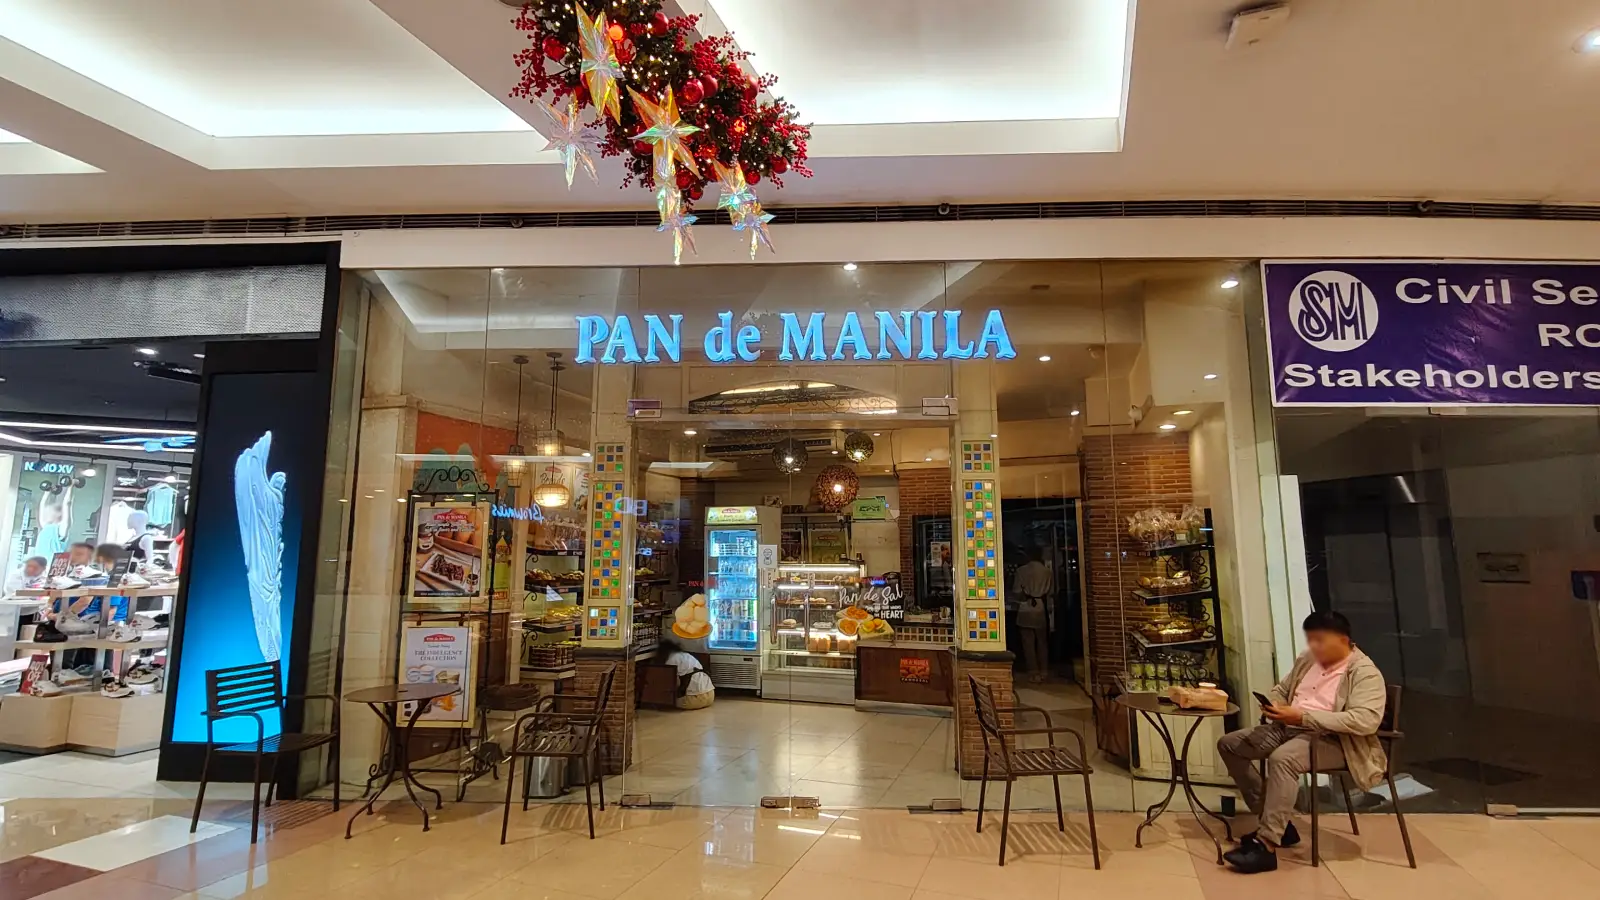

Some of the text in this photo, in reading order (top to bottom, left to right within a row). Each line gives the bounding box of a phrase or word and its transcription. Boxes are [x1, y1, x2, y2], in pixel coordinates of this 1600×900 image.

[1396, 278, 1599, 305] Civil Se
[1298, 279, 1368, 342] SM
[575, 308, 1017, 364] PAN de MANILA
[1284, 362, 1600, 390] Stakeholders
[24, 461, 57, 474] NNO
[839, 583, 903, 608] Pan de Sal
[880, 610, 904, 620] HEART
